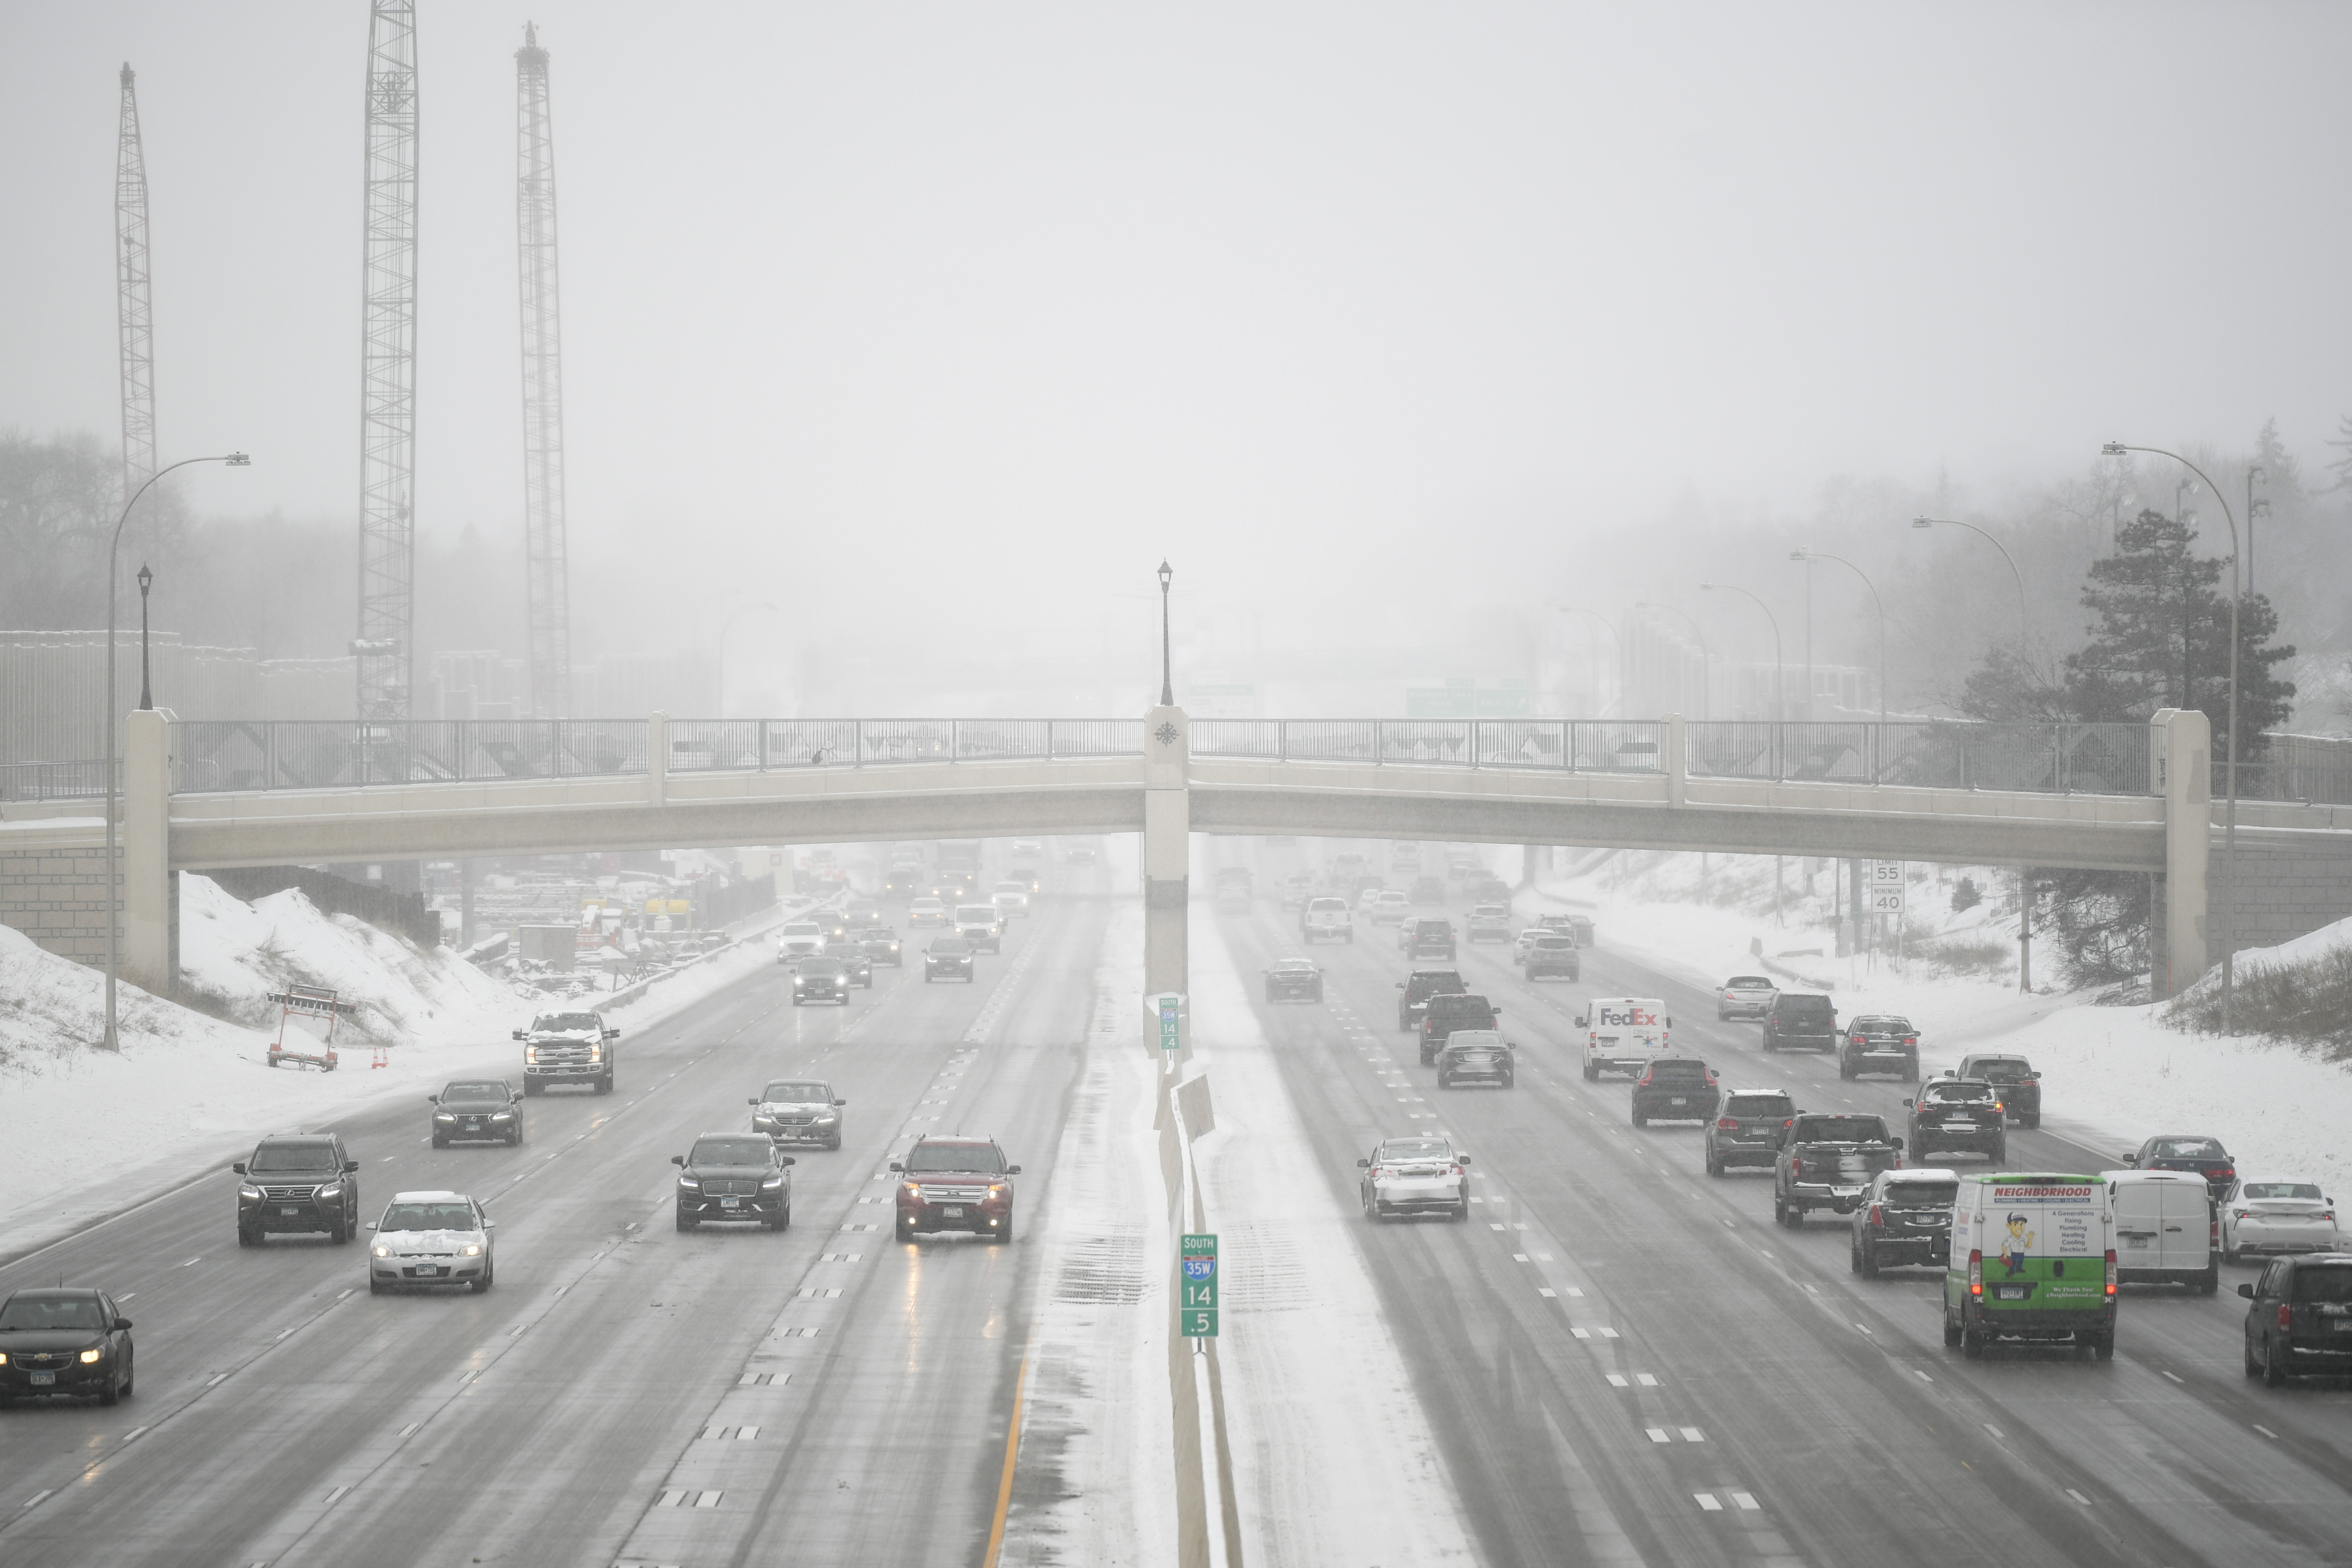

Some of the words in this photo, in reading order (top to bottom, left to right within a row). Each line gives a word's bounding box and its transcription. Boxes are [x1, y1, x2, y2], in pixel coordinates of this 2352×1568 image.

[1878, 867, 1899, 879] 55
[1877, 896, 1899, 909] 40
[1601, 1008, 1657, 1026] FedEx
[1164, 1024, 1175, 1033] 14
[1994, 1187, 2091, 1196] NEIGHBORHOOD
[1184, 1237, 1214, 1249] SOUTH
[1187, 1262, 1210, 1275] 35W
[1189, 1286, 1211, 1305] 14
